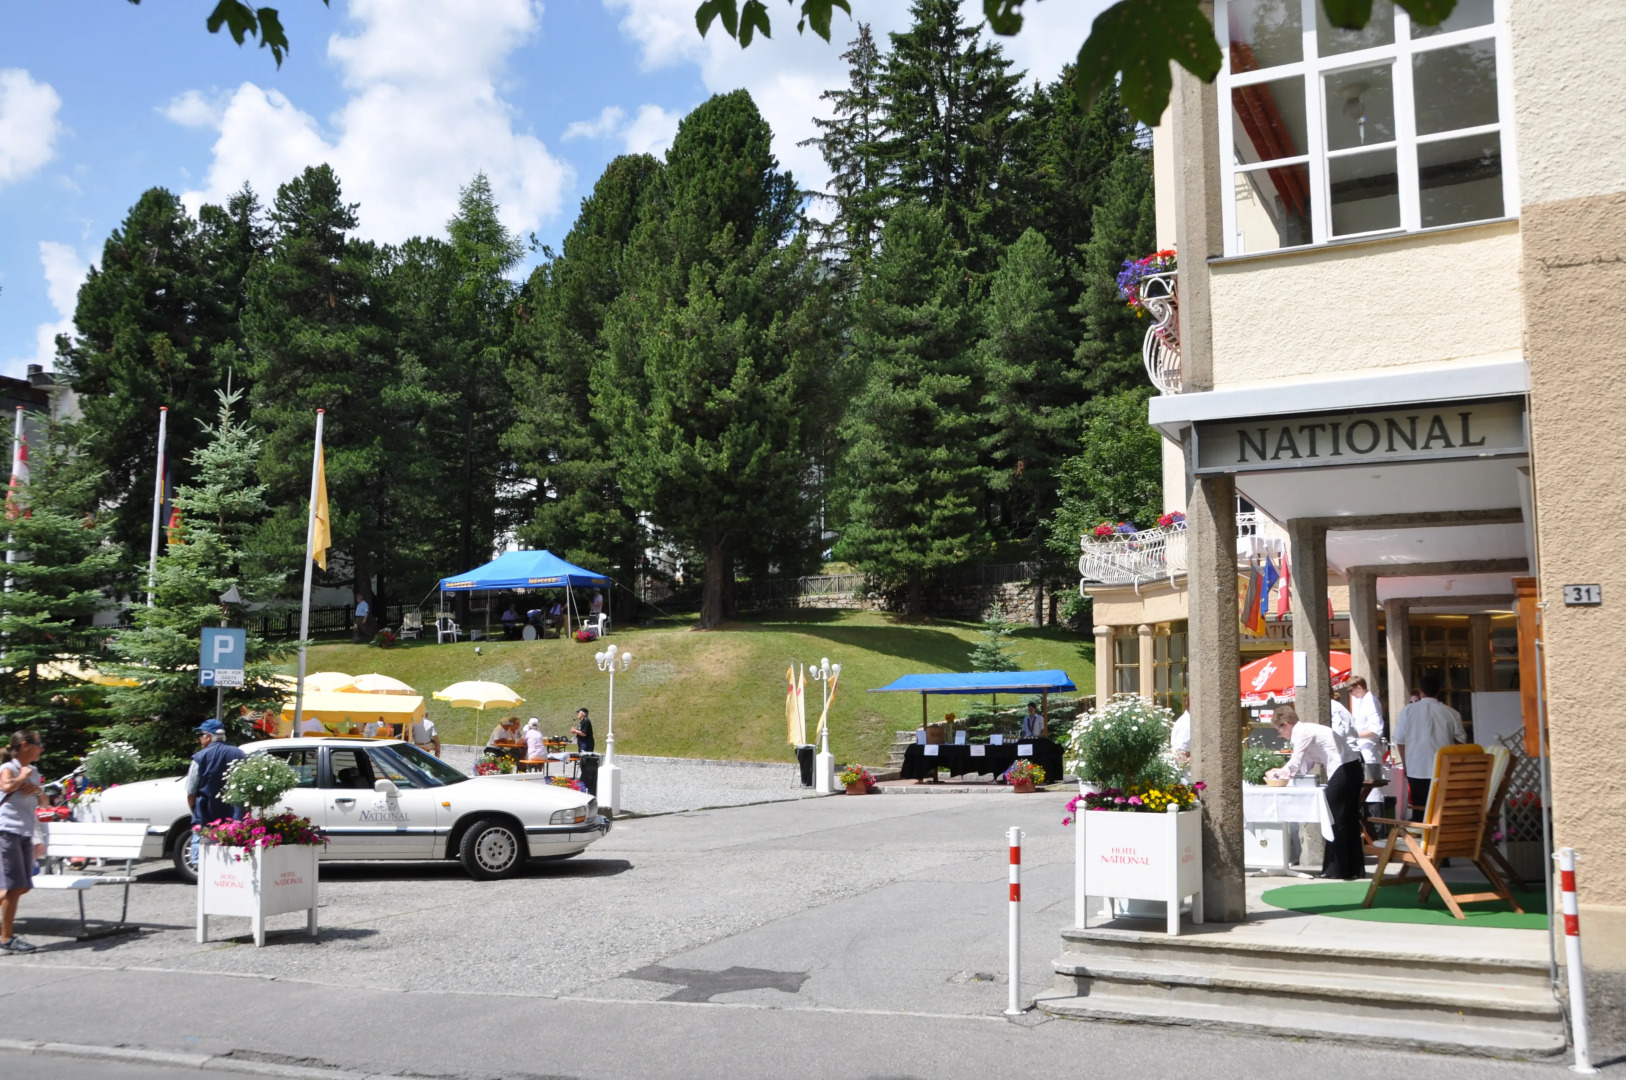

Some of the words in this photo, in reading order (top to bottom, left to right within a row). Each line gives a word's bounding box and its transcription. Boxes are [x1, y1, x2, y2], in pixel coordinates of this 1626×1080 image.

[1236, 411, 1487, 463] NATIONAL
[1572, 587, 1592, 601] 31
[213, 635, 234, 663] P
[201, 669, 214, 684] P
[1111, 847, 1137, 855] HOTEL
[1101, 855, 1150, 866] NATIONAL
[274, 877, 303, 886] NATIONAL
